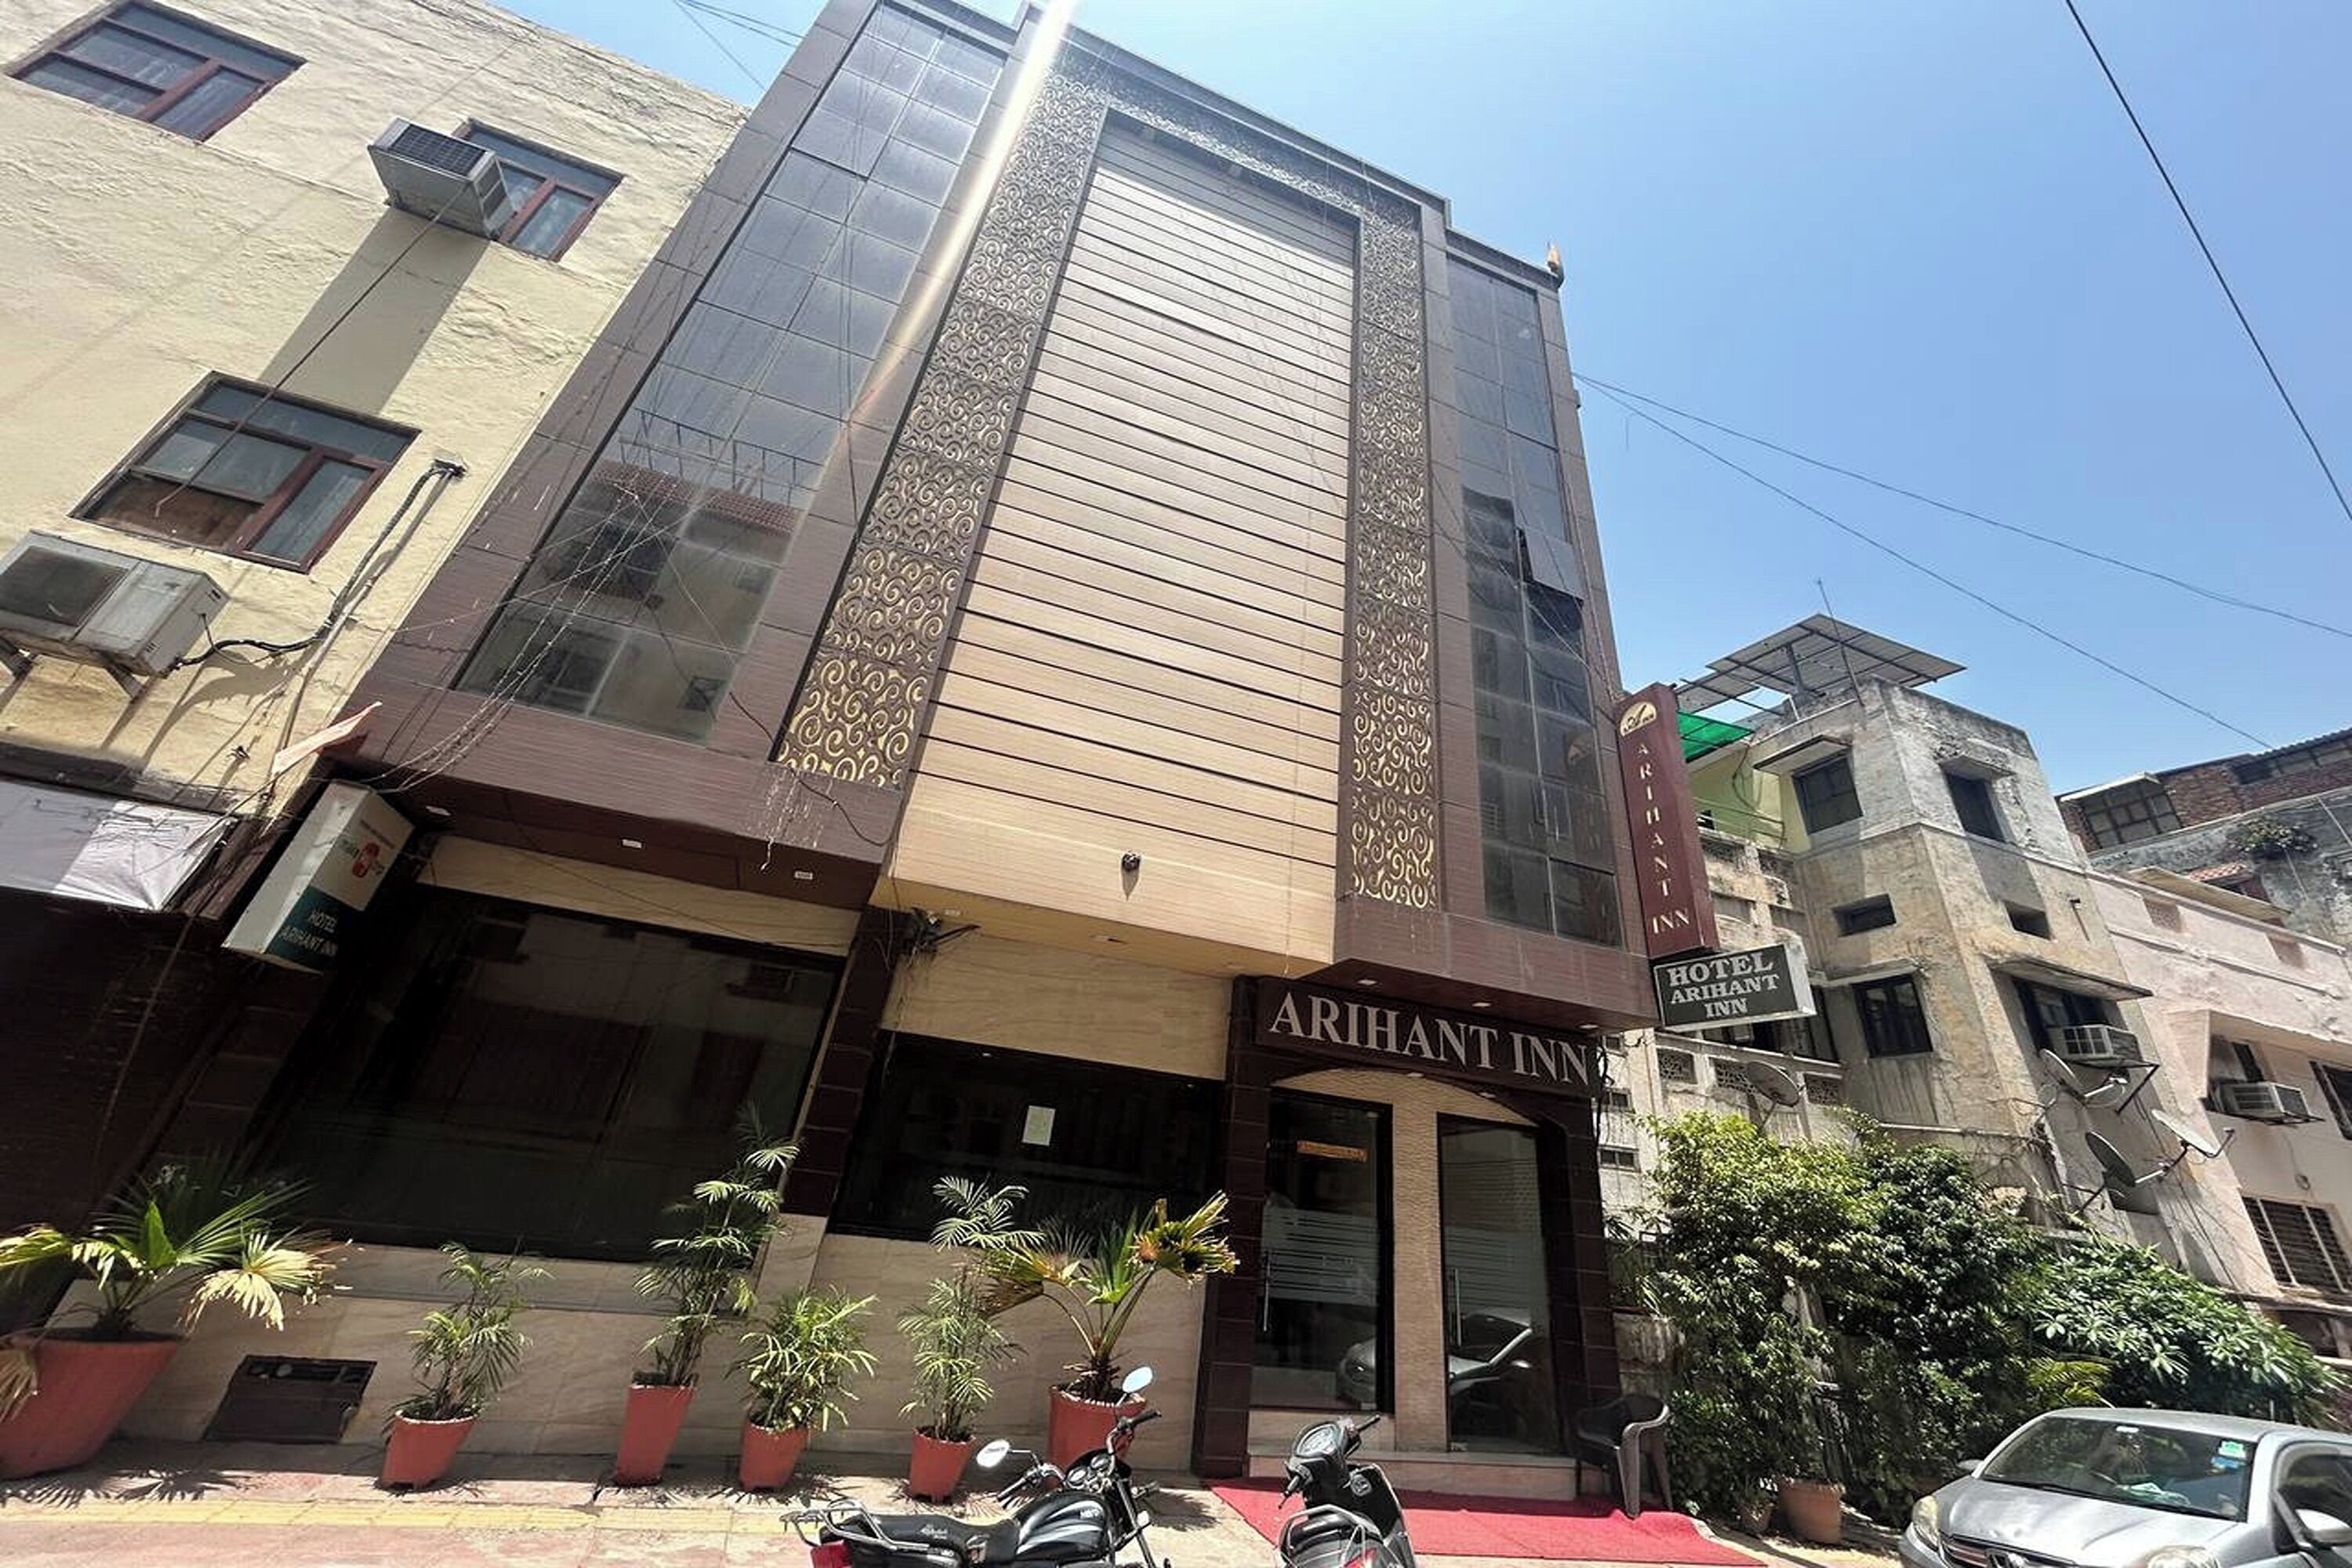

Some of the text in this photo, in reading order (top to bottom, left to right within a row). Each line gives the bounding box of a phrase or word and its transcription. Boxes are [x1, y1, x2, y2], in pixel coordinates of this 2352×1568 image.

[1637, 744, 1671, 897] ARIHANT
[1652, 907, 1690, 935] INN
[1668, 952, 1774, 987] HOTEL
[1671, 974, 1780, 1004] ARIHANT
[1704, 997, 1748, 1018] INN
[1269, 991, 1589, 1086] ARIHANT INN
